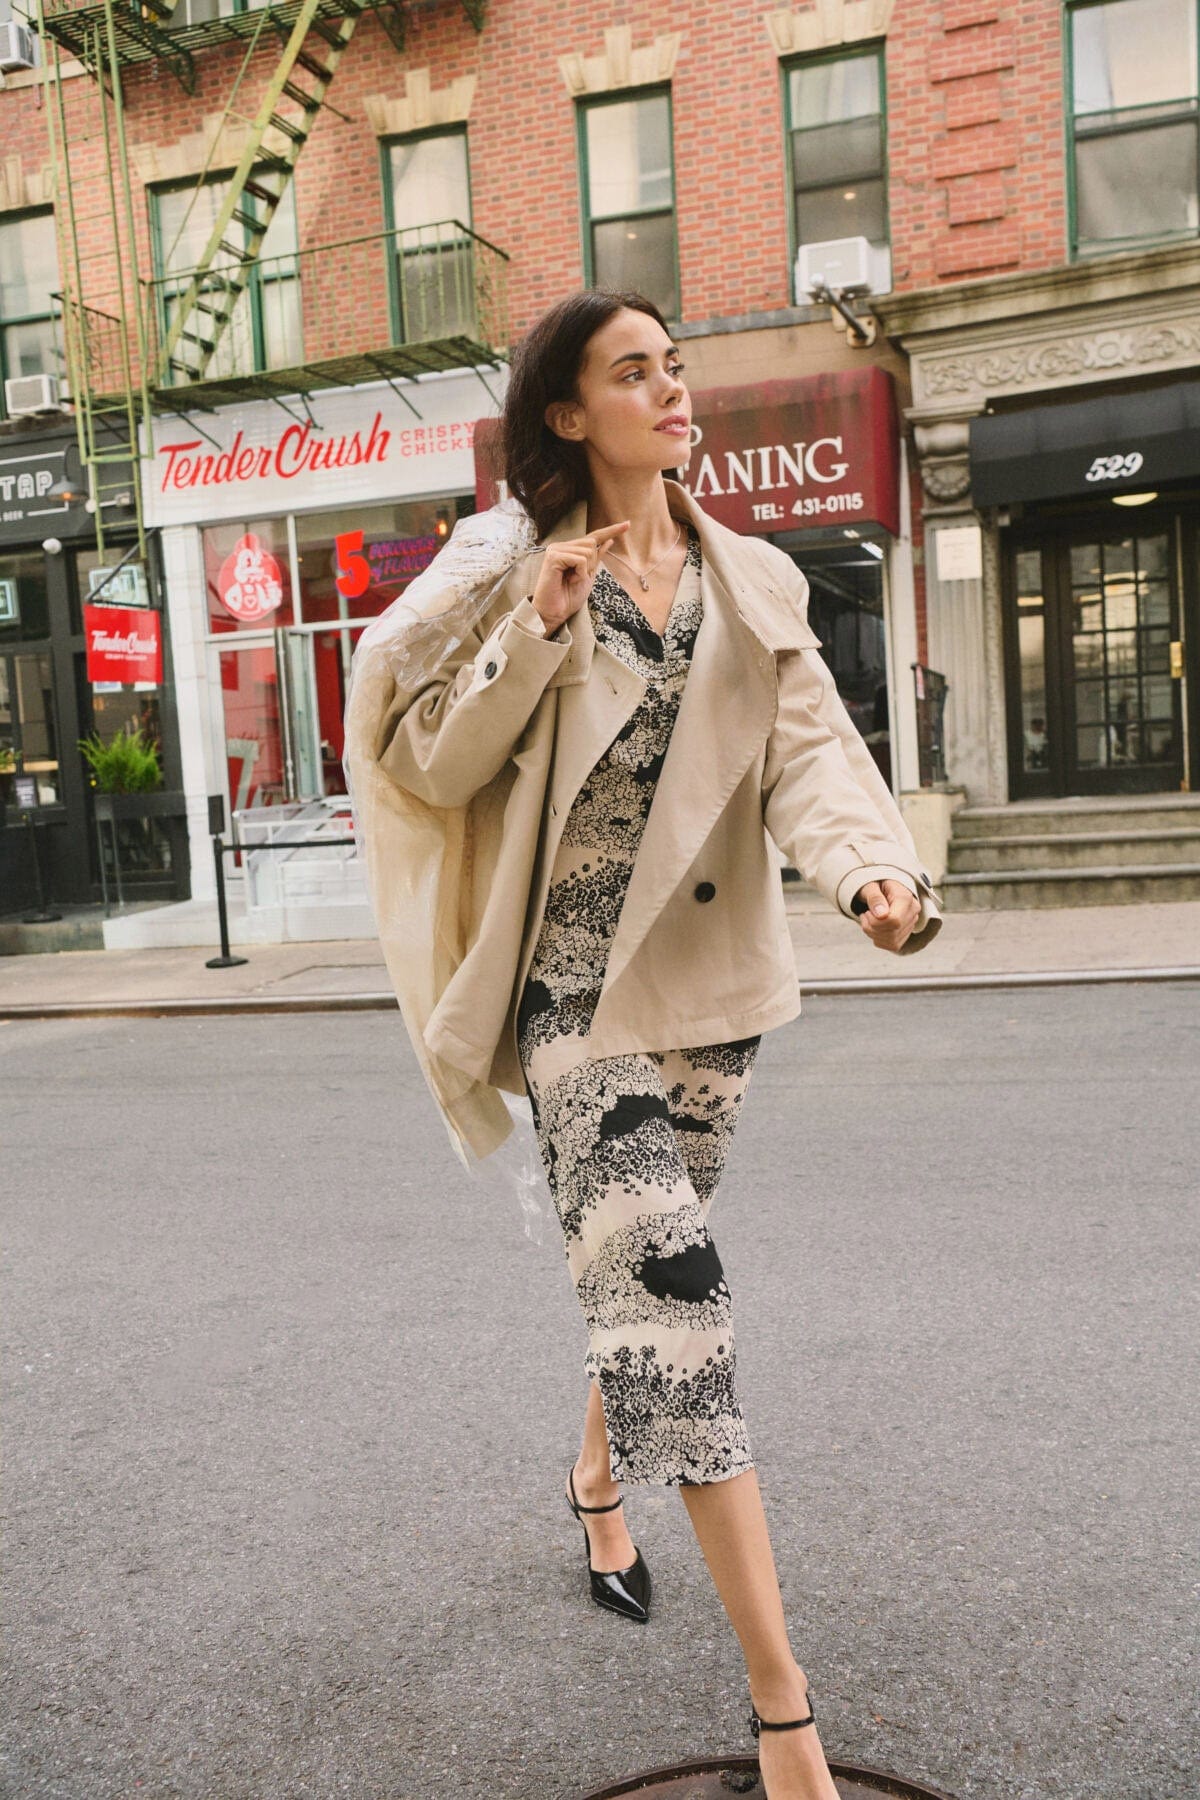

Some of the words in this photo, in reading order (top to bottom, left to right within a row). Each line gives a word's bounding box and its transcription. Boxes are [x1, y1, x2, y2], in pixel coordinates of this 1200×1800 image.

[400, 421, 476, 443] CRISPY
[159, 411, 391, 493] TenderCrush
[1085, 451, 1144, 482] 529
[0, 470, 53, 501] TAP
[751, 503, 785, 521] TEL:
[791, 492, 864, 516] 431-0115
[335, 528, 371, 599] 5
